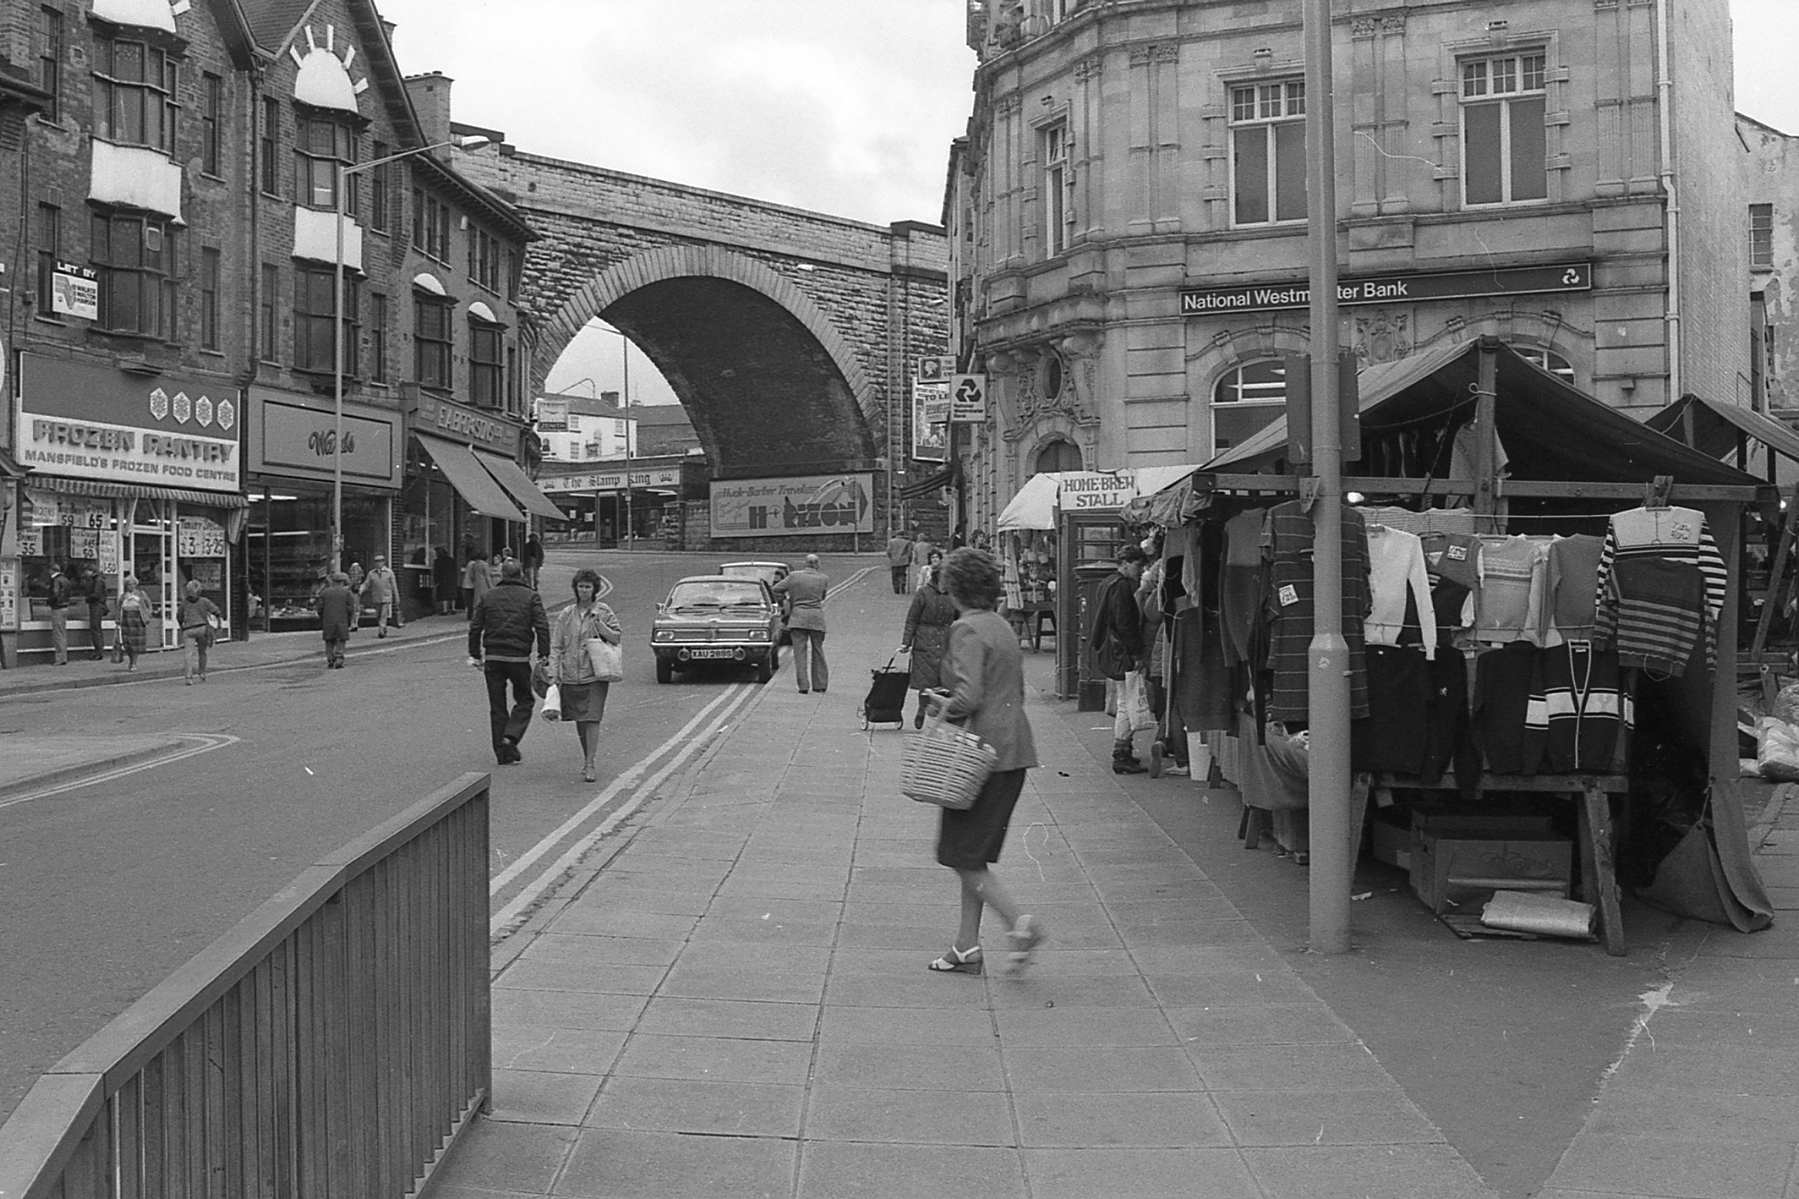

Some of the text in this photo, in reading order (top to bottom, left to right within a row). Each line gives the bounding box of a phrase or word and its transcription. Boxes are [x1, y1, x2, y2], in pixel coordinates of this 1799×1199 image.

[57, 261, 79, 274] LET
[1184, 281, 1409, 310] National Westmter Bank
[33, 420, 236, 463] FROZEN PANTRY
[25, 450, 237, 482] MANSFIELD'S FROZEN FOOD CENTRE
[562, 477, 583, 490] The
[589, 474, 621, 490] Stamp
[1076, 493, 1125, 508] STALL
[89, 513, 103, 528] 65
